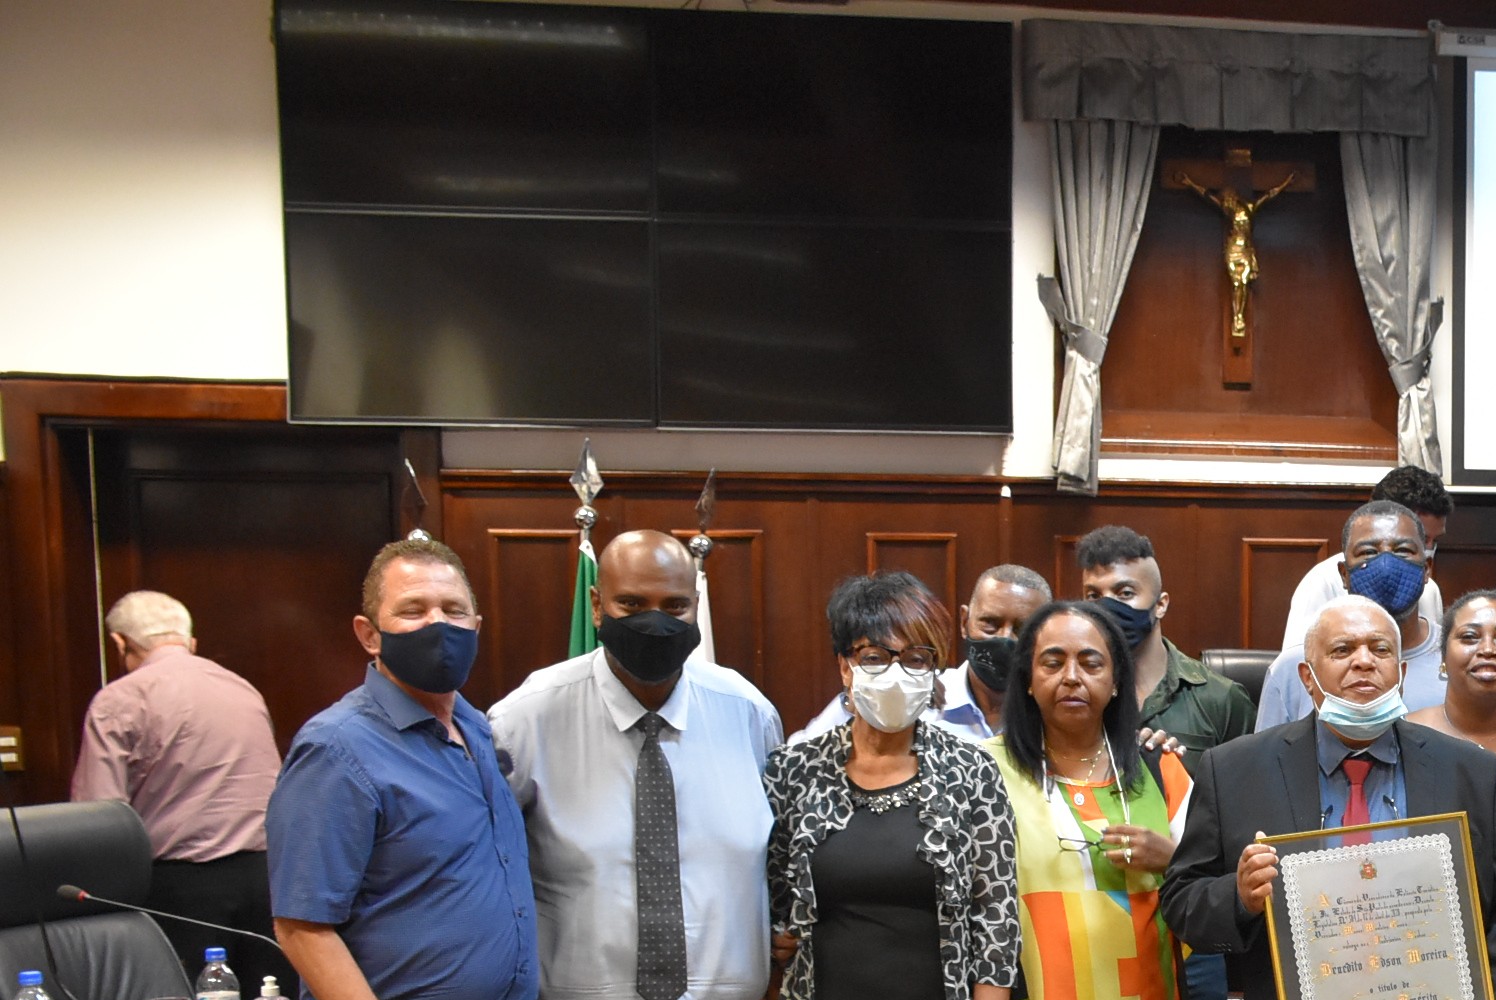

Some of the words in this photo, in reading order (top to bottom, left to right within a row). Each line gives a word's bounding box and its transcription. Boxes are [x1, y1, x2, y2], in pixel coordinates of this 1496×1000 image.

[1320, 961, 1363, 976] Benedito
[1369, 956, 1402, 969] Edson
[1406, 949, 1448, 964] Moreira
